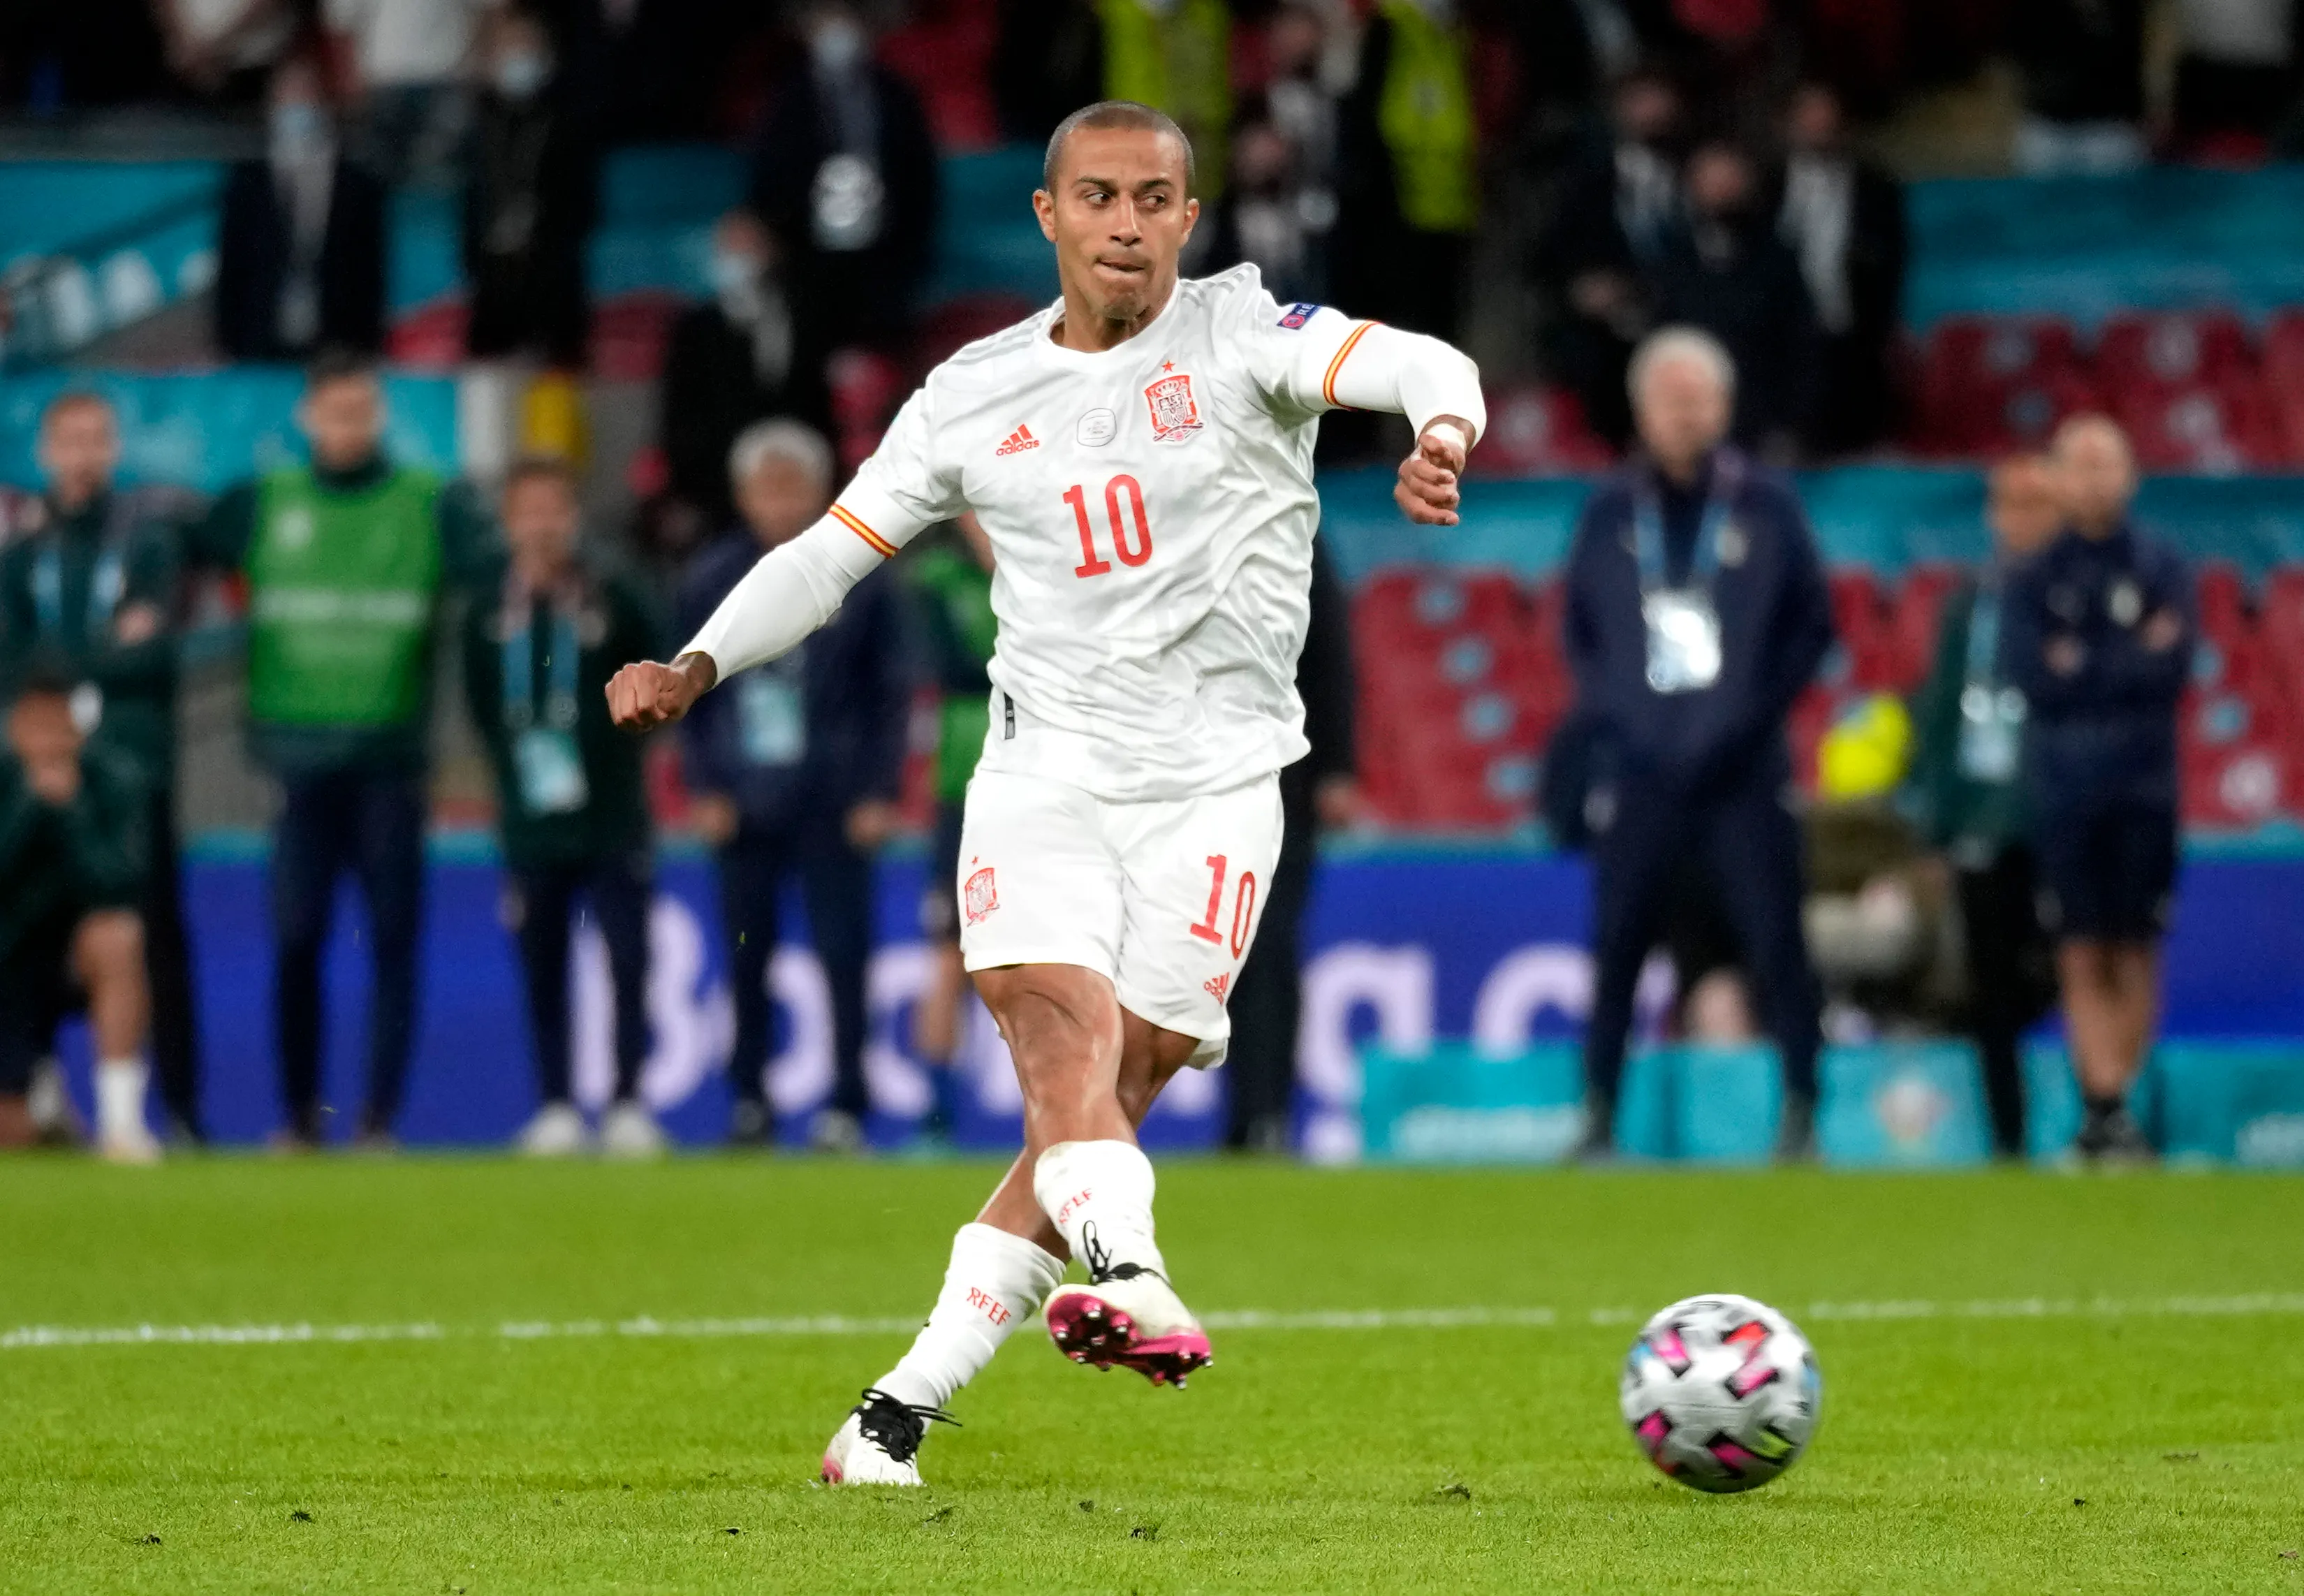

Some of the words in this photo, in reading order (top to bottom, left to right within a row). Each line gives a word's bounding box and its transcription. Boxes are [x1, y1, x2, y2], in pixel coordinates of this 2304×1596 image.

[995, 439, 1040, 456] adidas
[1062, 474, 1153, 578] 10
[1189, 854, 1256, 960] 10
[967, 1287, 1011, 1325] RFEF
